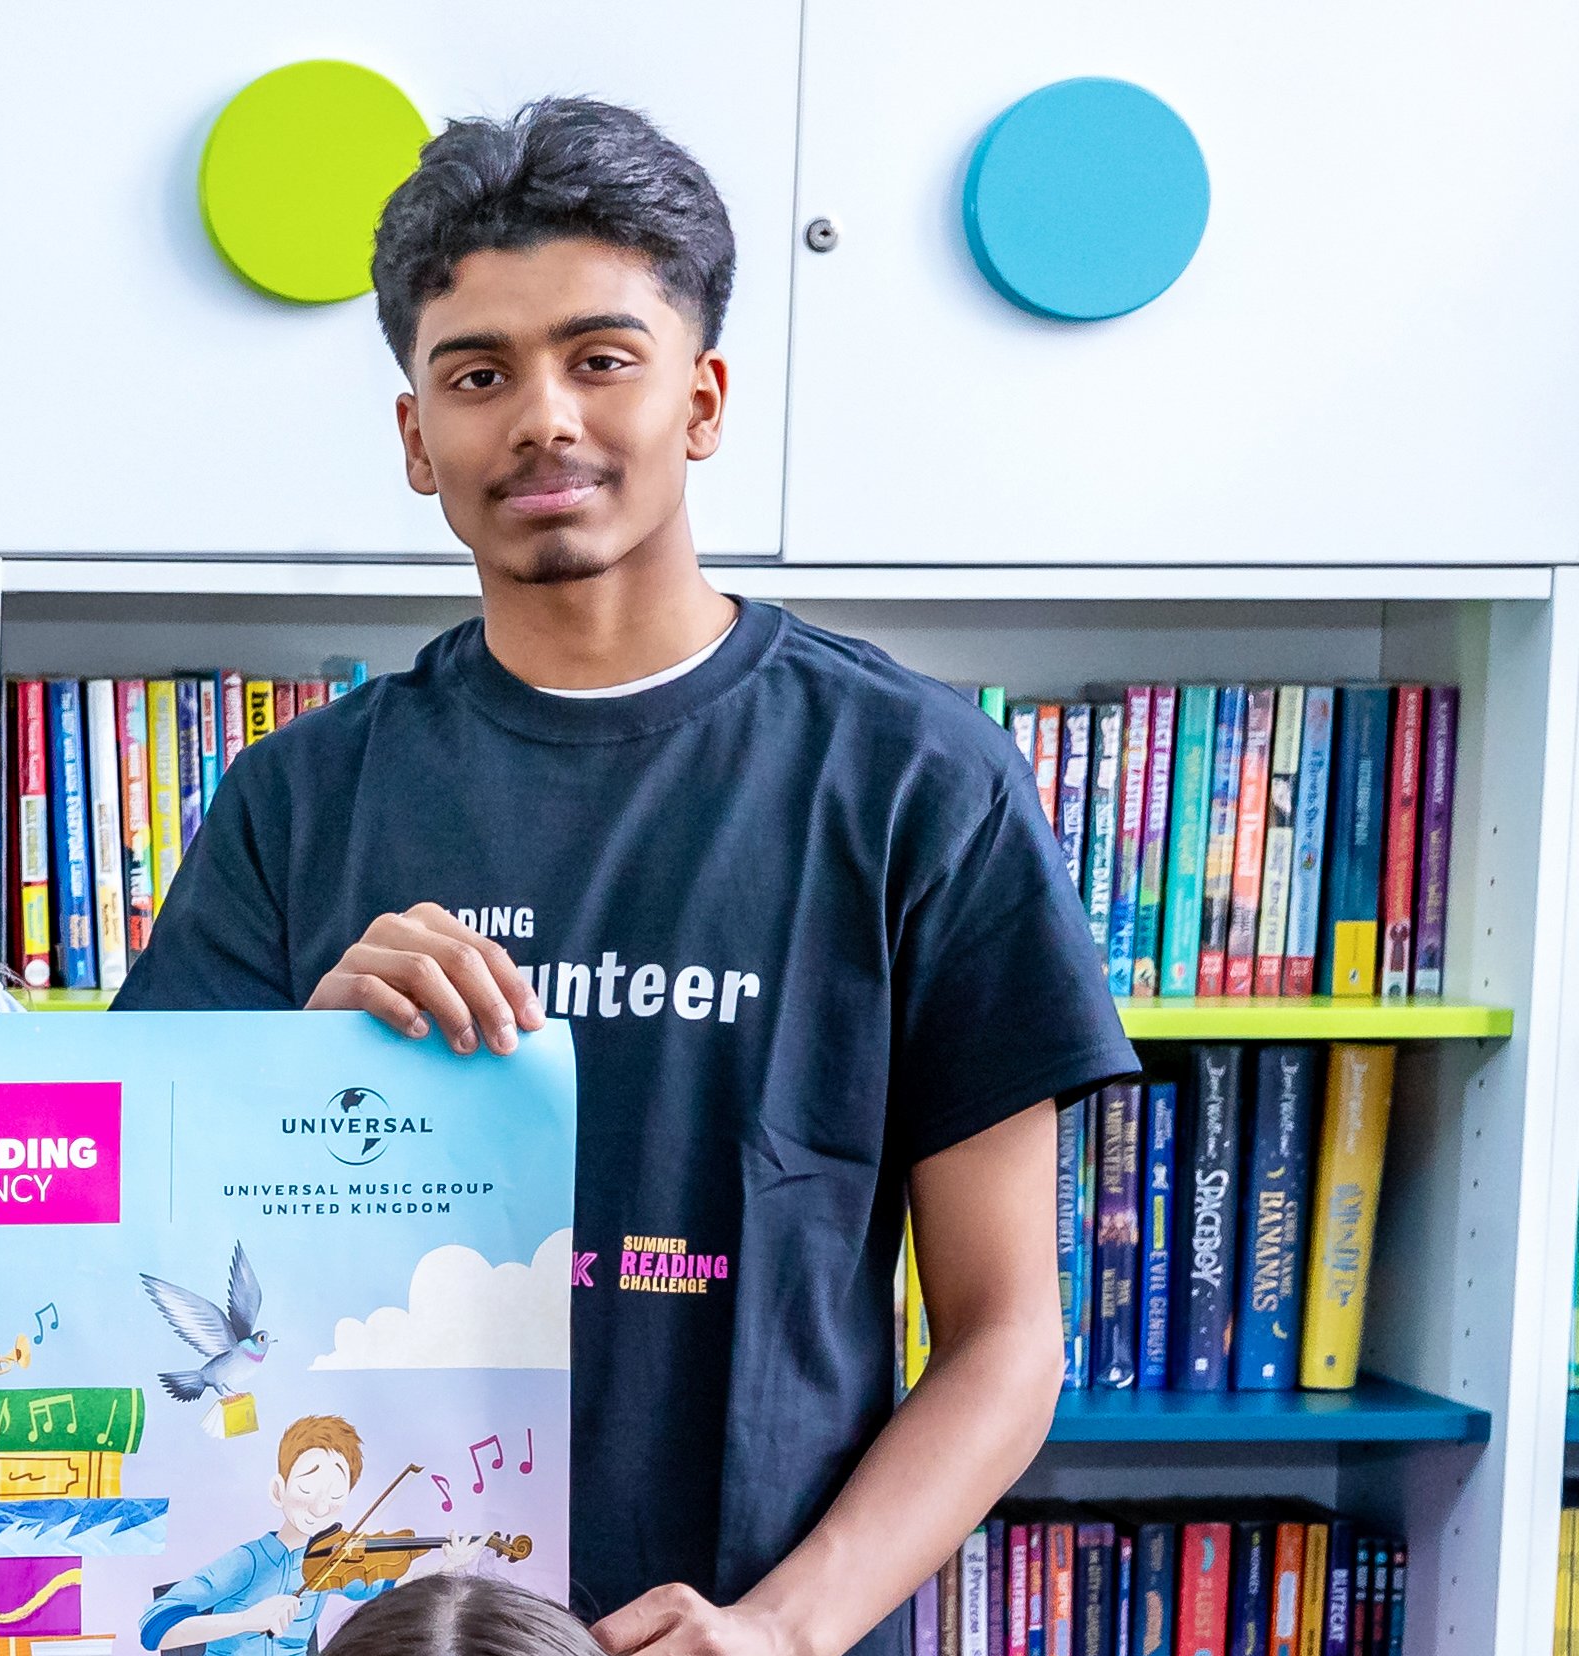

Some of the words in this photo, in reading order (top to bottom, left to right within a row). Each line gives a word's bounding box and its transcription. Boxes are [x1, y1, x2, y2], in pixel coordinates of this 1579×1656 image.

[516, 951, 761, 1023] unteer
[281, 1116, 434, 1137] UNIVERSAL
[223, 1184, 341, 1197] UNIVERSAL
[348, 1183, 415, 1196] MUSIC
[422, 1182, 495, 1195] GROUP
[261, 1202, 344, 1216] UNITED
[350, 1201, 452, 1215] KINGDOM
[1191, 1169, 1229, 1290] SPACEBOY
[623, 1236, 687, 1255] SUMMER
[1252, 1191, 1285, 1312] BANANAS
[620, 1253, 728, 1279] READING
[619, 1277, 708, 1294] CHALLENGE
[1329, 1568, 1348, 1643] BLITZCAT
